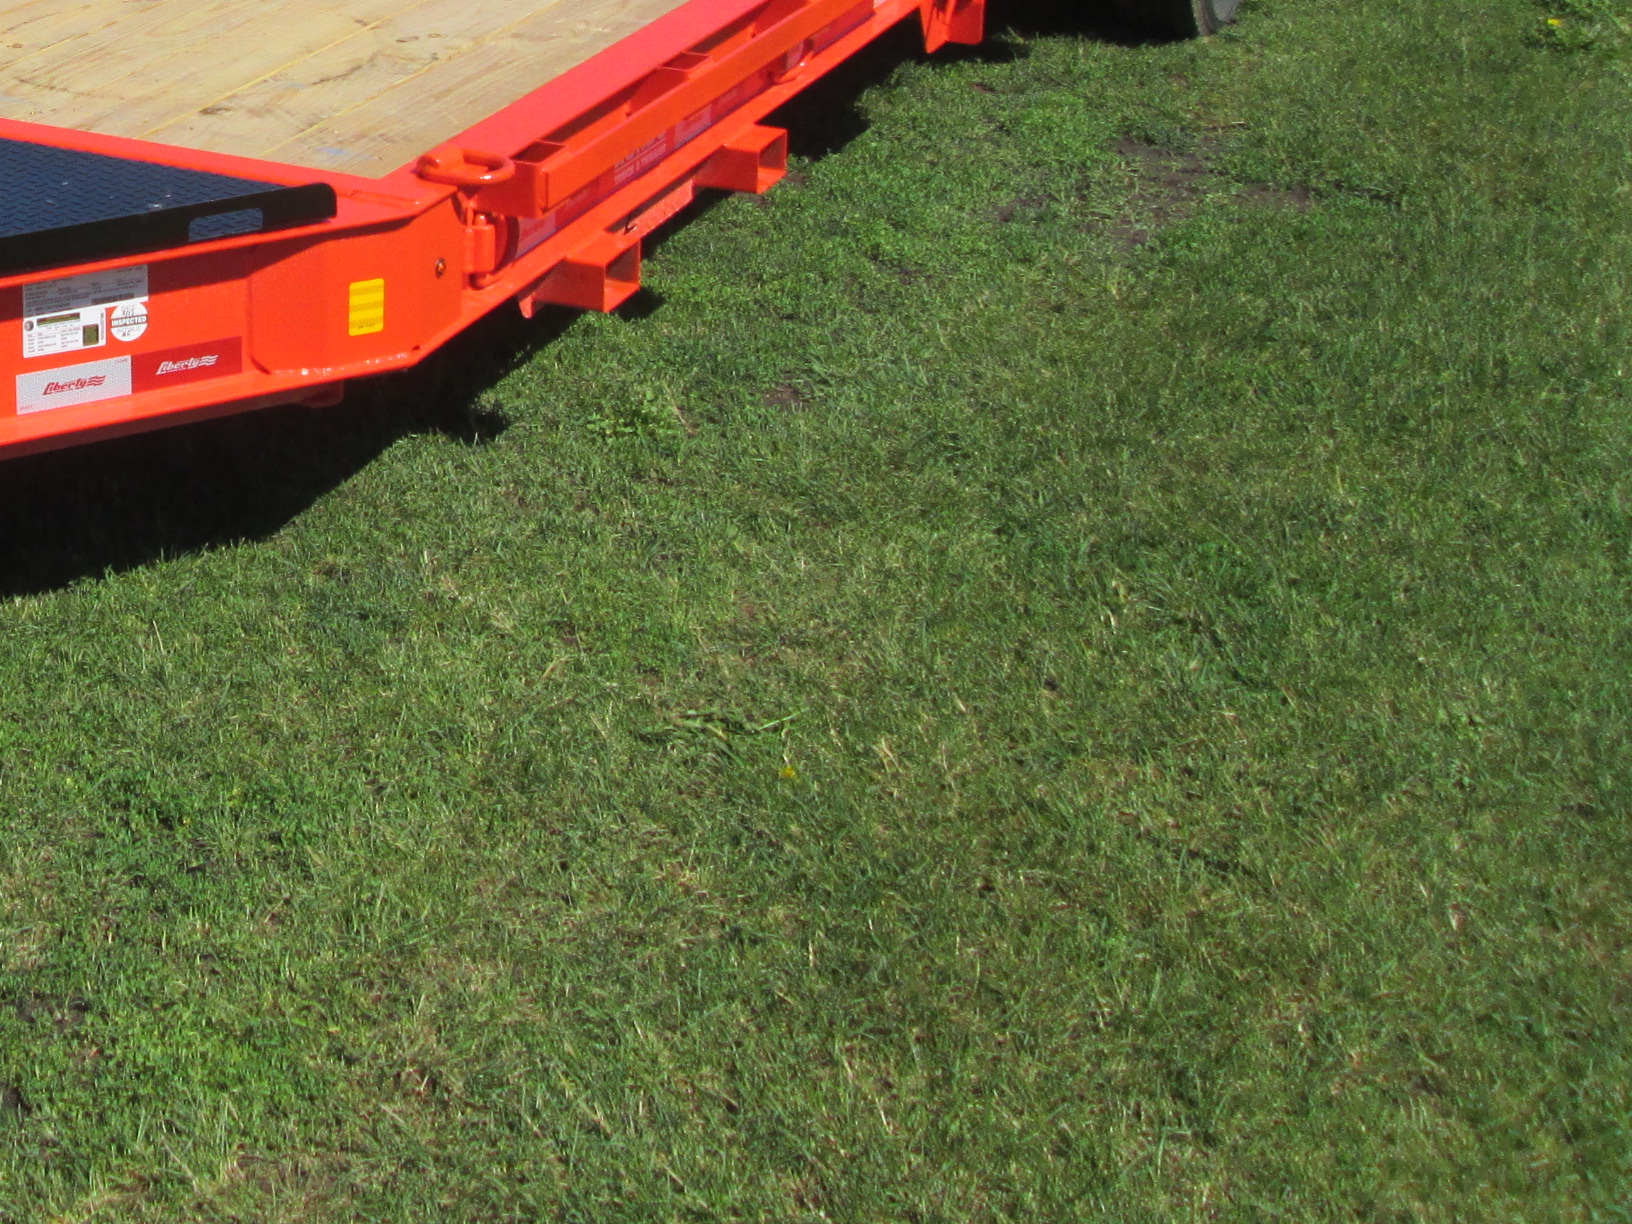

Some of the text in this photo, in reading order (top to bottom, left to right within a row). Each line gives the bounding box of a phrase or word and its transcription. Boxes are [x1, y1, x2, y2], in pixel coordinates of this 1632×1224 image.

[111, 315, 147, 327] INSPECTED
[155, 356, 199, 375] Liberty
[42, 378, 87, 395] Liberty
